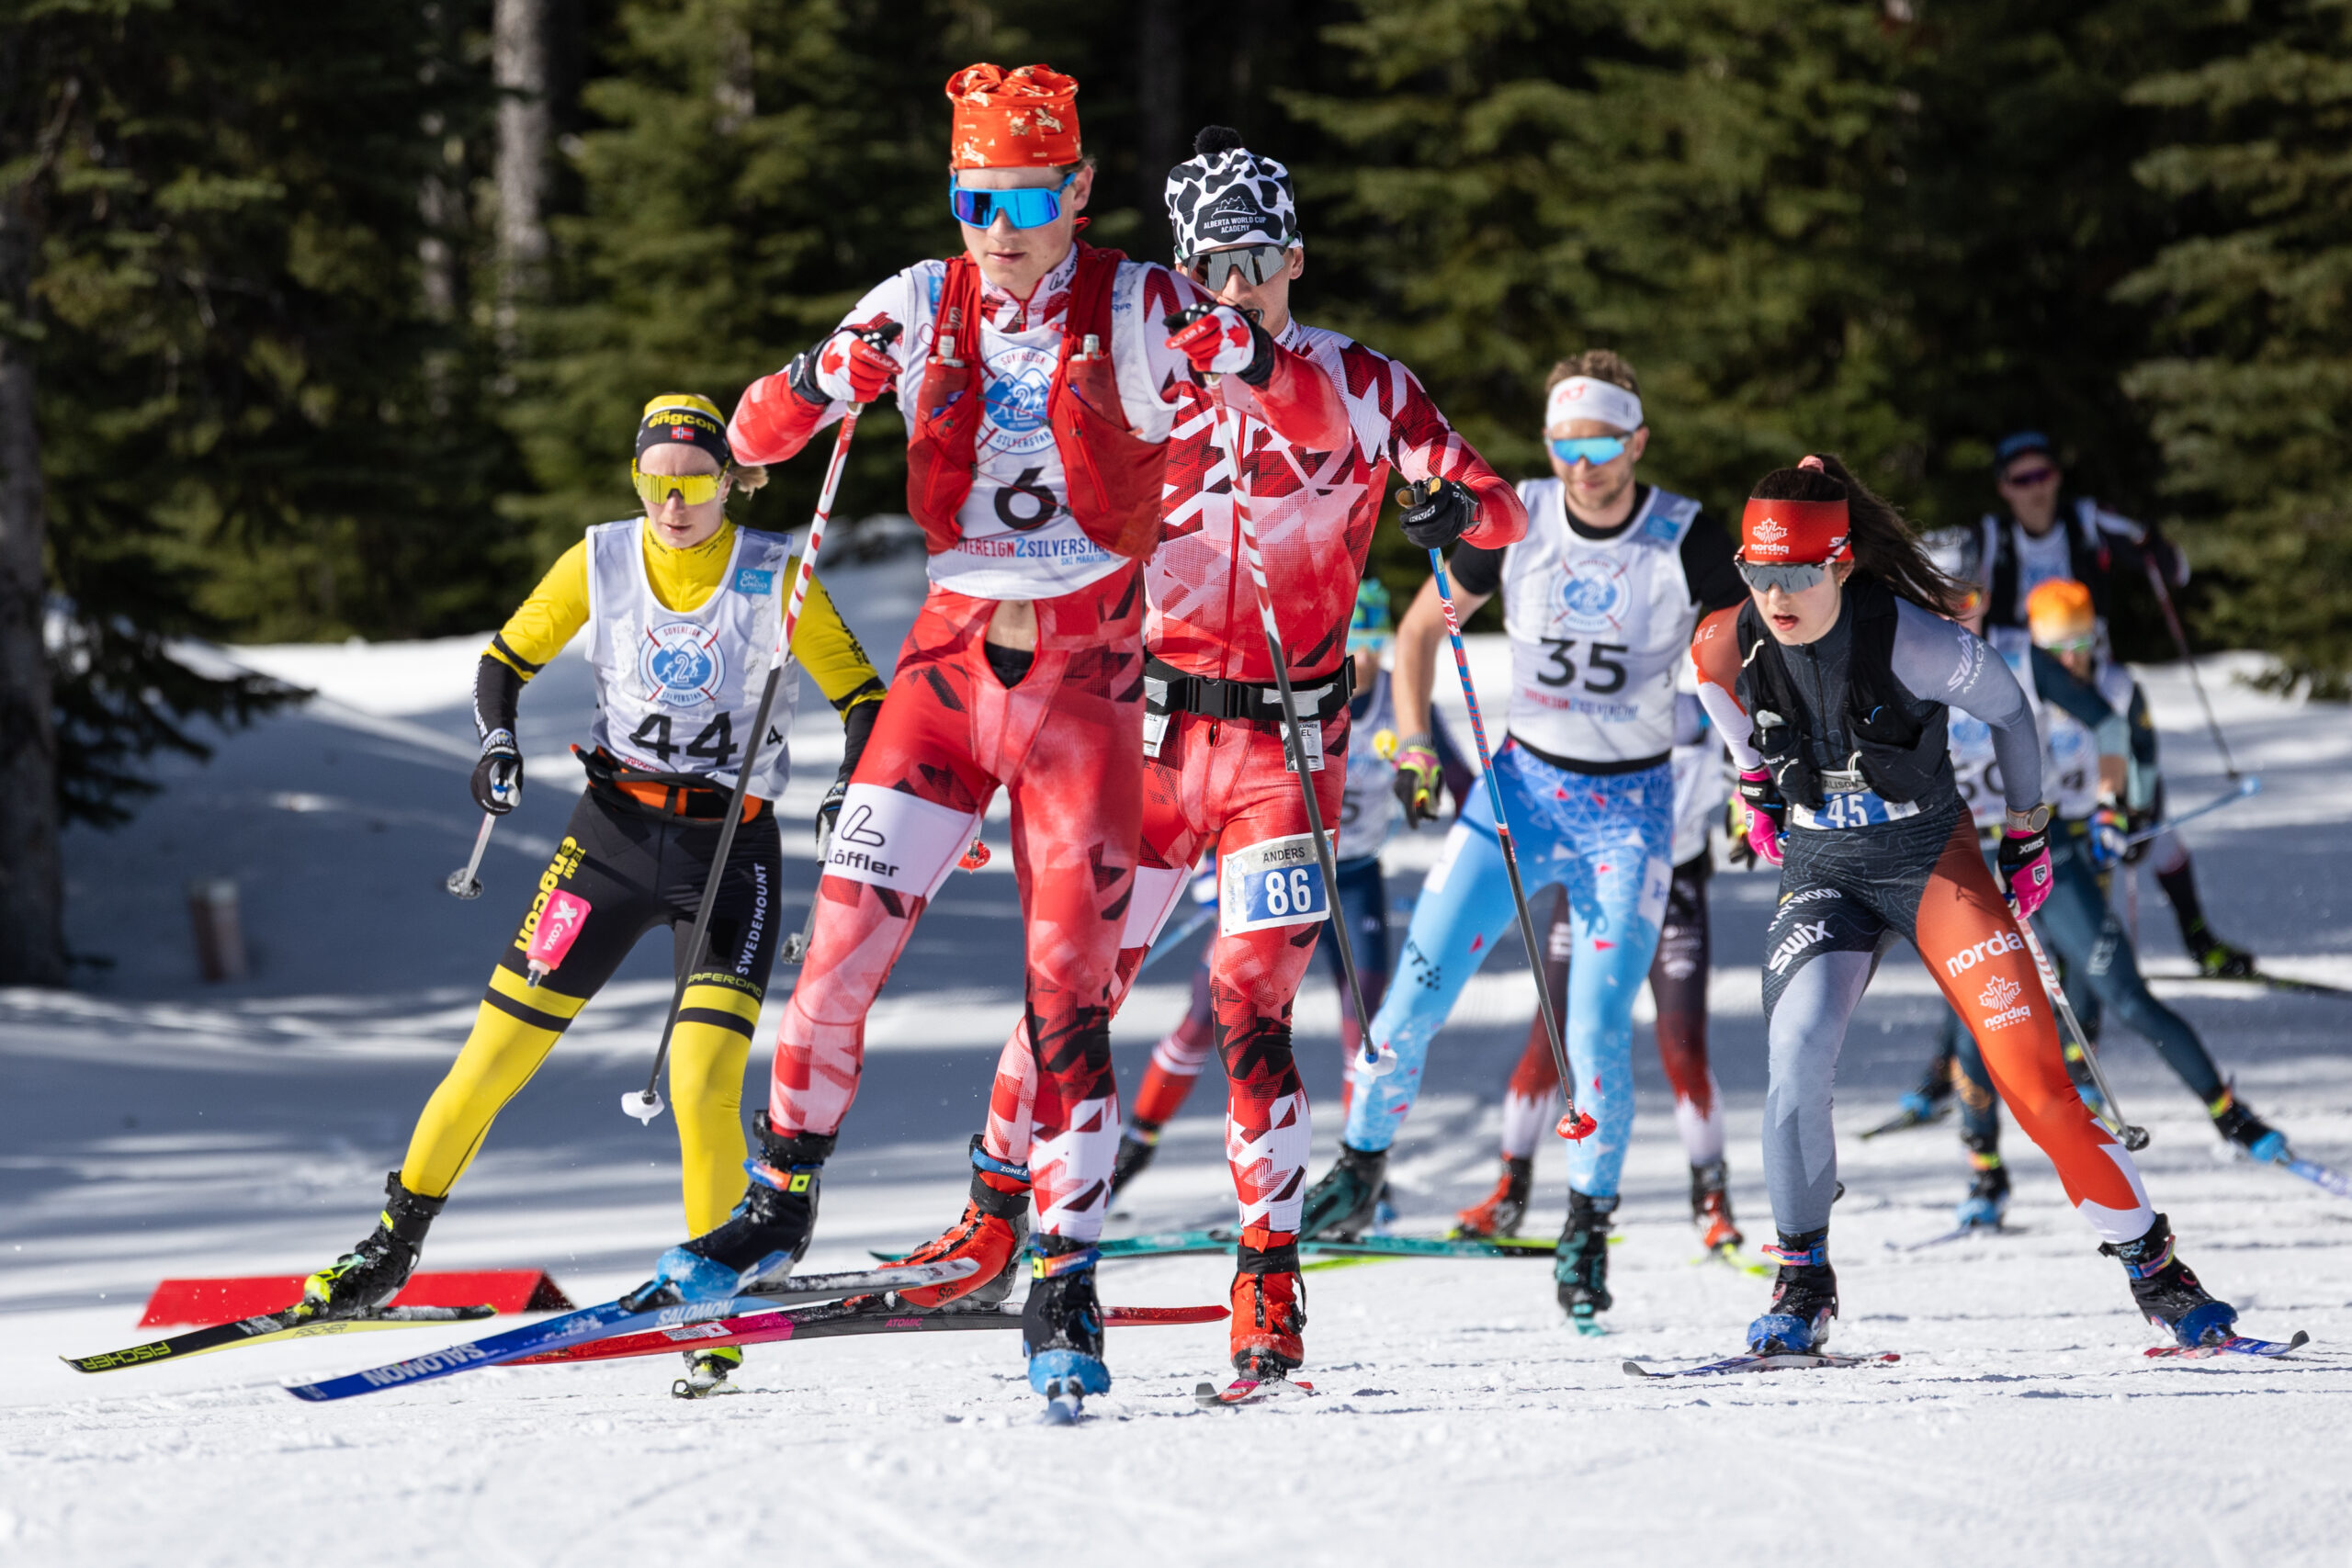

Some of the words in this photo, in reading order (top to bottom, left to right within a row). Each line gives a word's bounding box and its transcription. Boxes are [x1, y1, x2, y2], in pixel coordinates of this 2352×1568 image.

[1204, 218, 1230, 230] ALBERTA
[1230, 216, 1254, 225] WORLD
[1254, 216, 1267, 224] CUP
[1221, 224, 1250, 234] ACADEMY
[1012, 384, 1034, 421] 2
[648, 412, 717, 434] engcon
[996, 431, 1052, 448] SILVERSTAR
[994, 466, 1057, 530] 6
[674, 653, 690, 683] 2
[1537, 636, 1628, 696] 35
[628, 711, 739, 767] 44
[1824, 780, 1860, 790] ALISON
[1827, 793, 1869, 829] 45
[563, 847, 586, 880] TEAM
[1262, 846, 1306, 864] ANDERS
[514, 836, 577, 953] engcon
[1265, 868, 1312, 916] 86
[736, 863, 768, 976] SWEDEMOUNT
[542, 922, 564, 952] COXA
[1946, 930, 2025, 978] norda
[1984, 1005, 2032, 1029] nordiq
[1991, 1017, 2027, 1032] CANADA
[1000, 1165, 1028, 1177] ZONE4
[655, 1301, 735, 1327] SALOMON
[884, 1316, 924, 1328] ATOMIC
[82, 1340, 172, 1371] FISCHER
[361, 1342, 487, 1389] SALOMON
